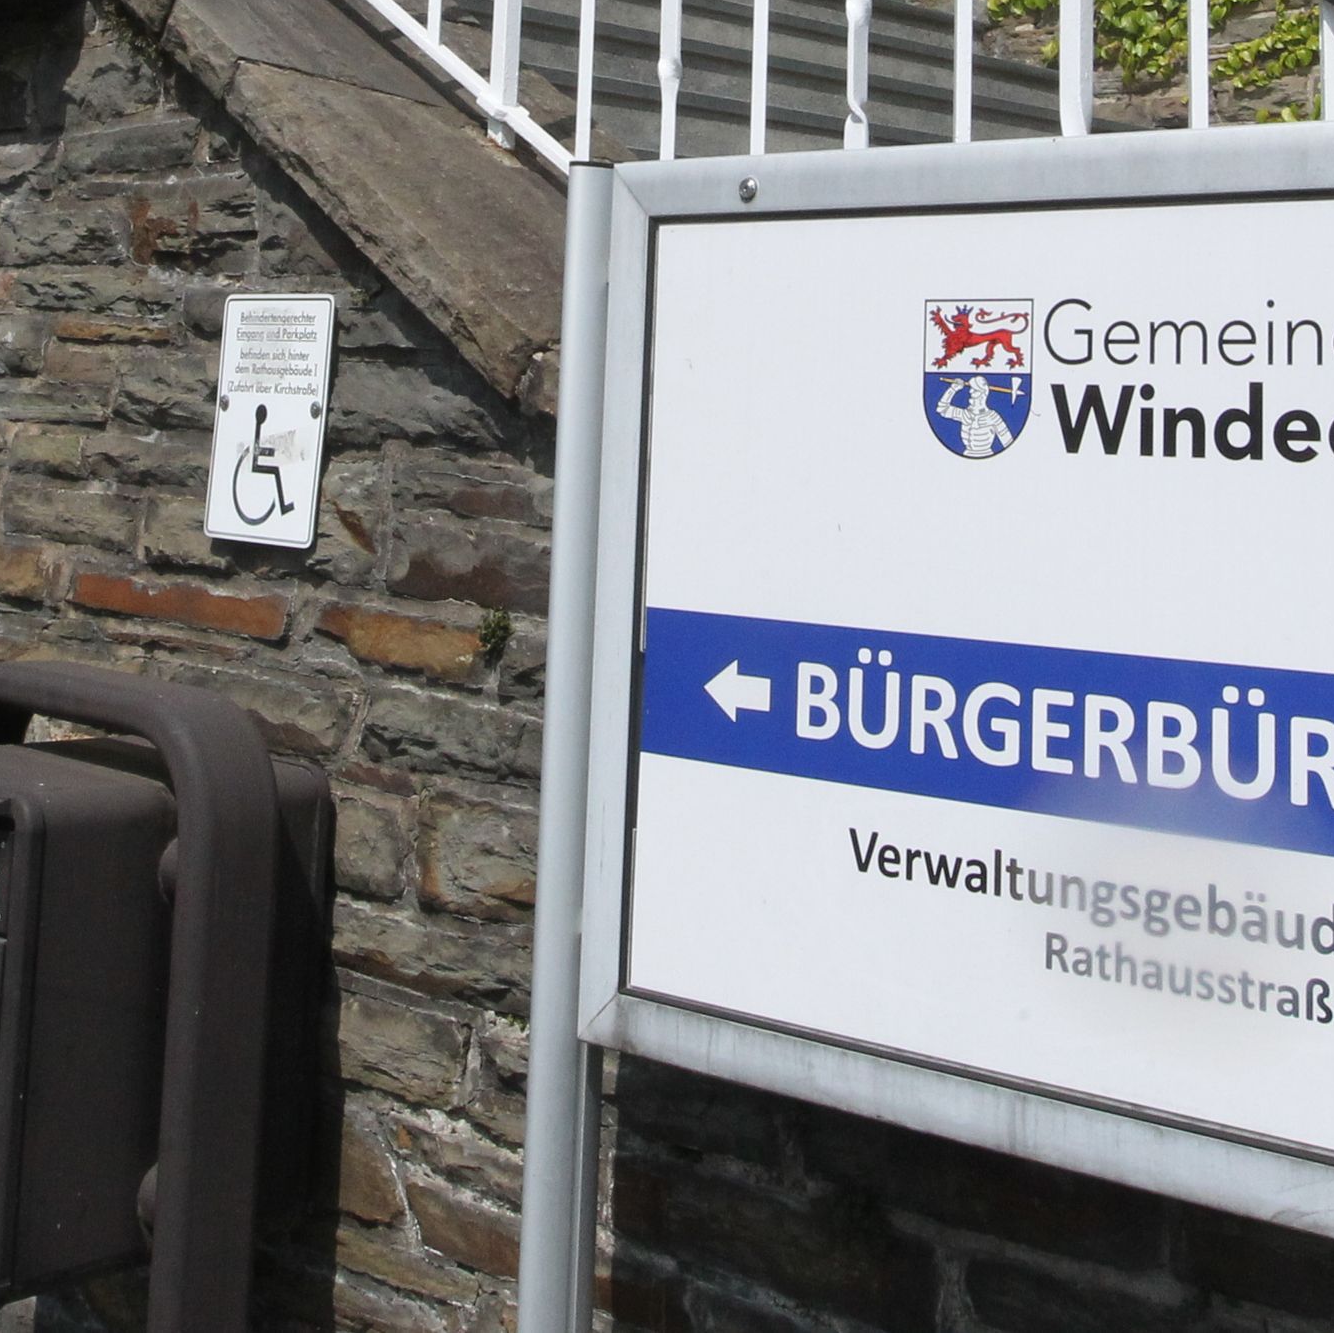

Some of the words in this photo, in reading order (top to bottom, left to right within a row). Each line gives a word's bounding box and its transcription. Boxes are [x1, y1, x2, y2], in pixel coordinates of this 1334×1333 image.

[240, 311, 316, 325] Behindertengerechter
[236, 327, 264, 341] Eingang
[266, 328, 280, 340] und
[282, 328, 317, 342] Parkplatz
[240, 347, 270, 360] befinden
[272, 349, 286, 360] sich
[288, 349, 310, 361] hinter
[235, 362, 250, 374] dem
[251, 363, 312, 378] Rathausgebäude
[227, 380, 254, 393] (Zufahrt
[255, 381, 272, 394] über
[273, 382, 319, 397] Kirchstraße)
